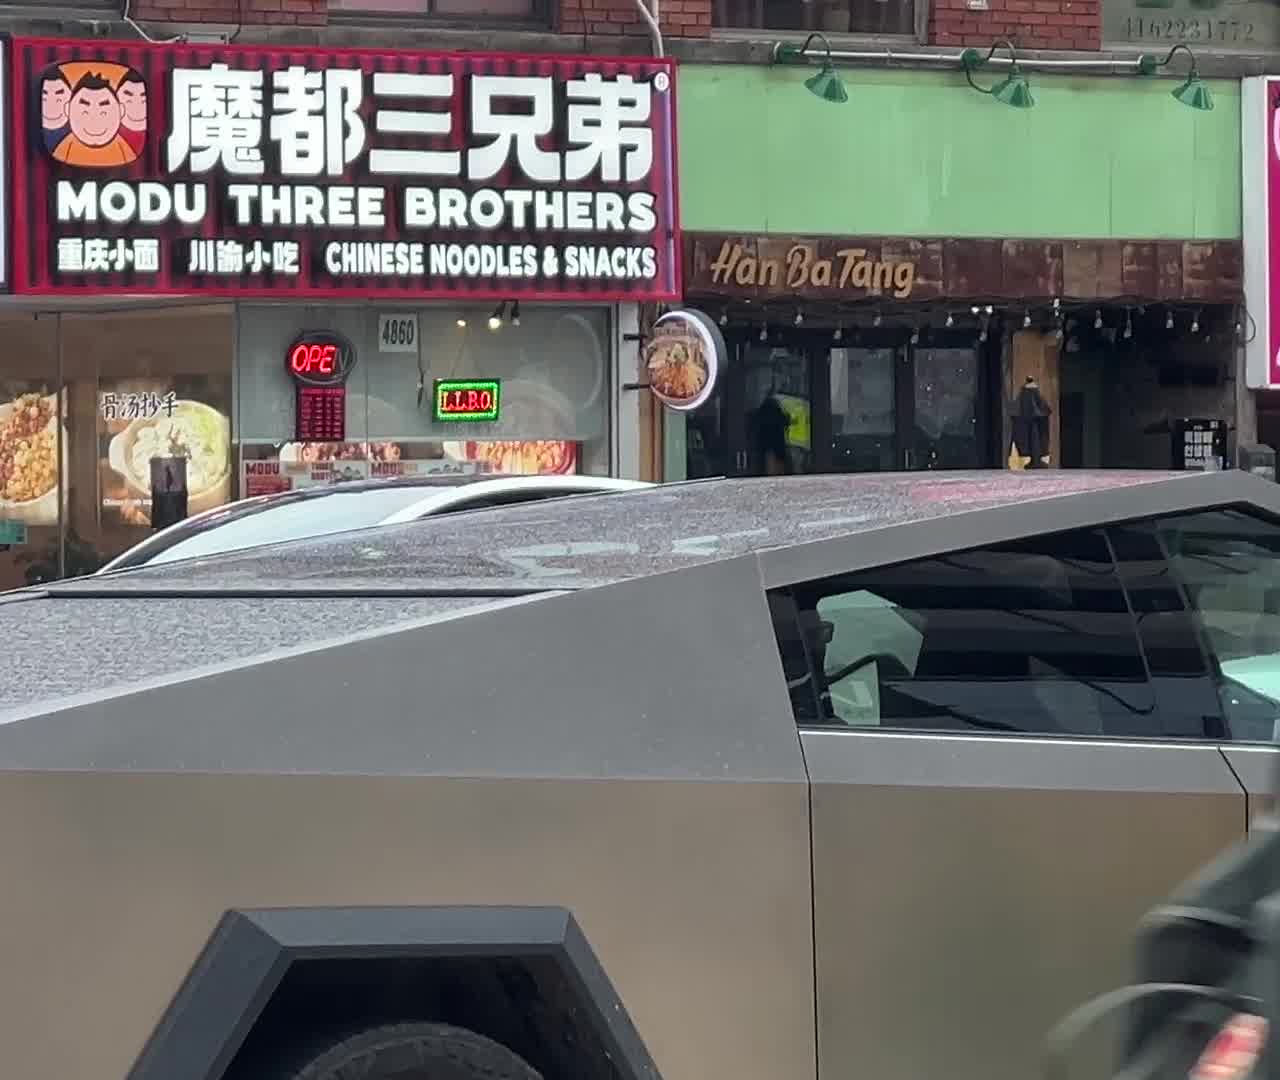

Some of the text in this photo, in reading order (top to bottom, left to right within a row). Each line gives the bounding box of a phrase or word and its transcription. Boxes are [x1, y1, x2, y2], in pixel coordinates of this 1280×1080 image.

[166, 63, 655, 184] 魔都三兄弟
[56, 180, 657, 231] MODU THREE BROTHERS
[58, 238, 159, 271] 重庆小面
[325, 242, 657, 278] CHINESE NOODLES & SNACKS
[710, 240, 915, 298] Han Ba Tang
[382, 320, 414, 344] 4860
[292, 345, 352, 373] OPEN
[103, 392, 179, 419] 骨汤抄手
